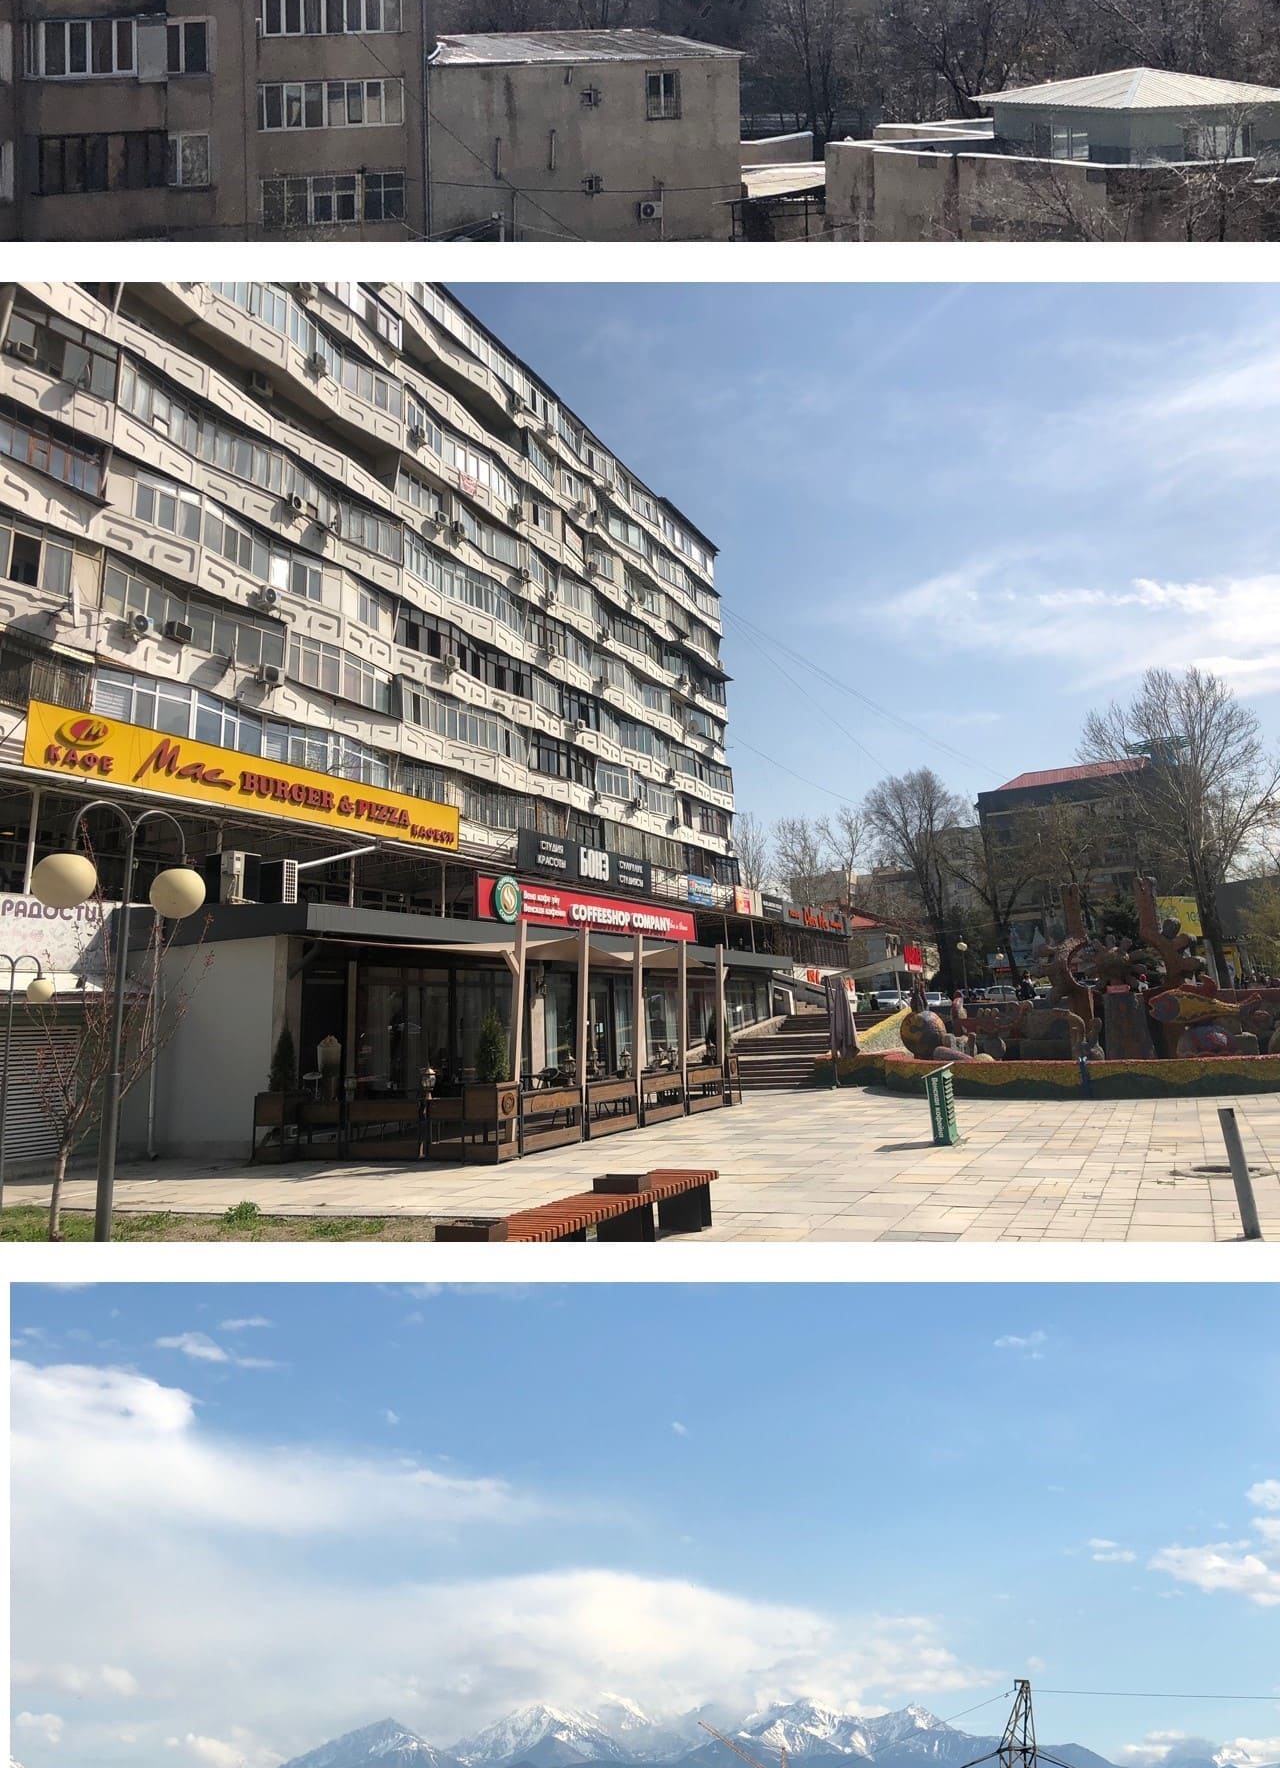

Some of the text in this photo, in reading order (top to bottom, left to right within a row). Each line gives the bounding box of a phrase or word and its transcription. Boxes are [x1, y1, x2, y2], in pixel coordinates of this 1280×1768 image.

[46, 744, 114, 774] КАФЕ
[242, 772, 335, 810] BURGER
[338, 795, 355, 814] &
[355, 798, 411, 828] PIZZA
[537, 854, 567, 869] КРАСОТЫ
[540, 840, 564, 854] СТУДИЯ
[579, 846, 610, 882] БОНЭ
[570, 903, 631, 926] COFFEESHOP
[631, 912, 671, 931] COMPANY
